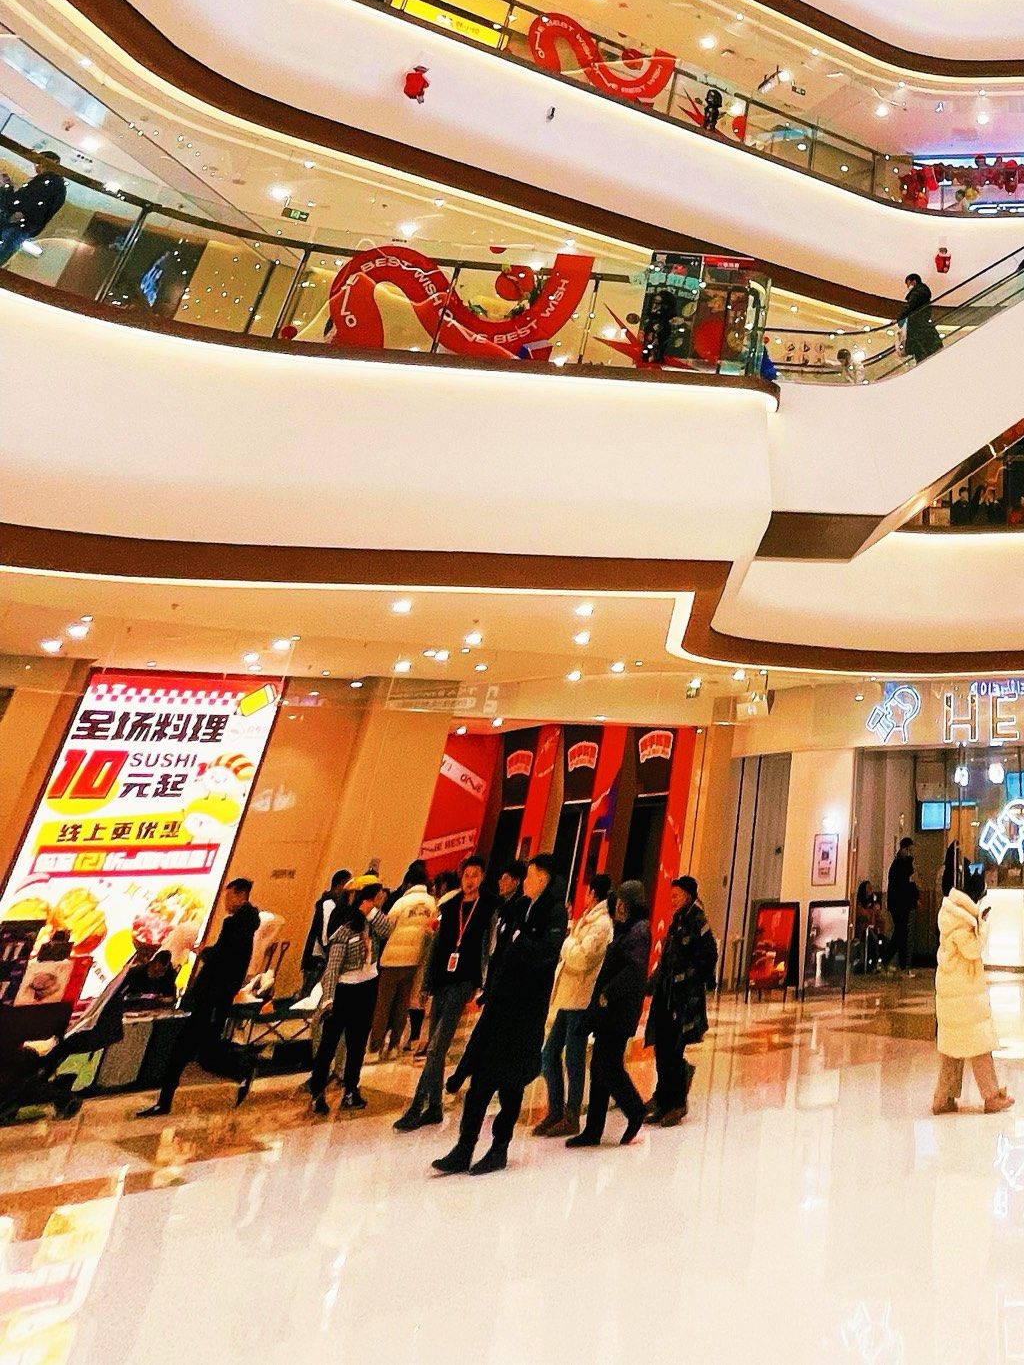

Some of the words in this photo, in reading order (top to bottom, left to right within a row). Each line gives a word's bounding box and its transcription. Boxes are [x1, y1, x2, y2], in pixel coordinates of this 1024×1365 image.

[493, 319, 538, 344] BEST
[130, 752, 197, 768] SUSHI
[47, 749, 129, 799] 10
[118, 773, 188, 798] 元起
[56, 820, 182, 843] 线上更优惠
